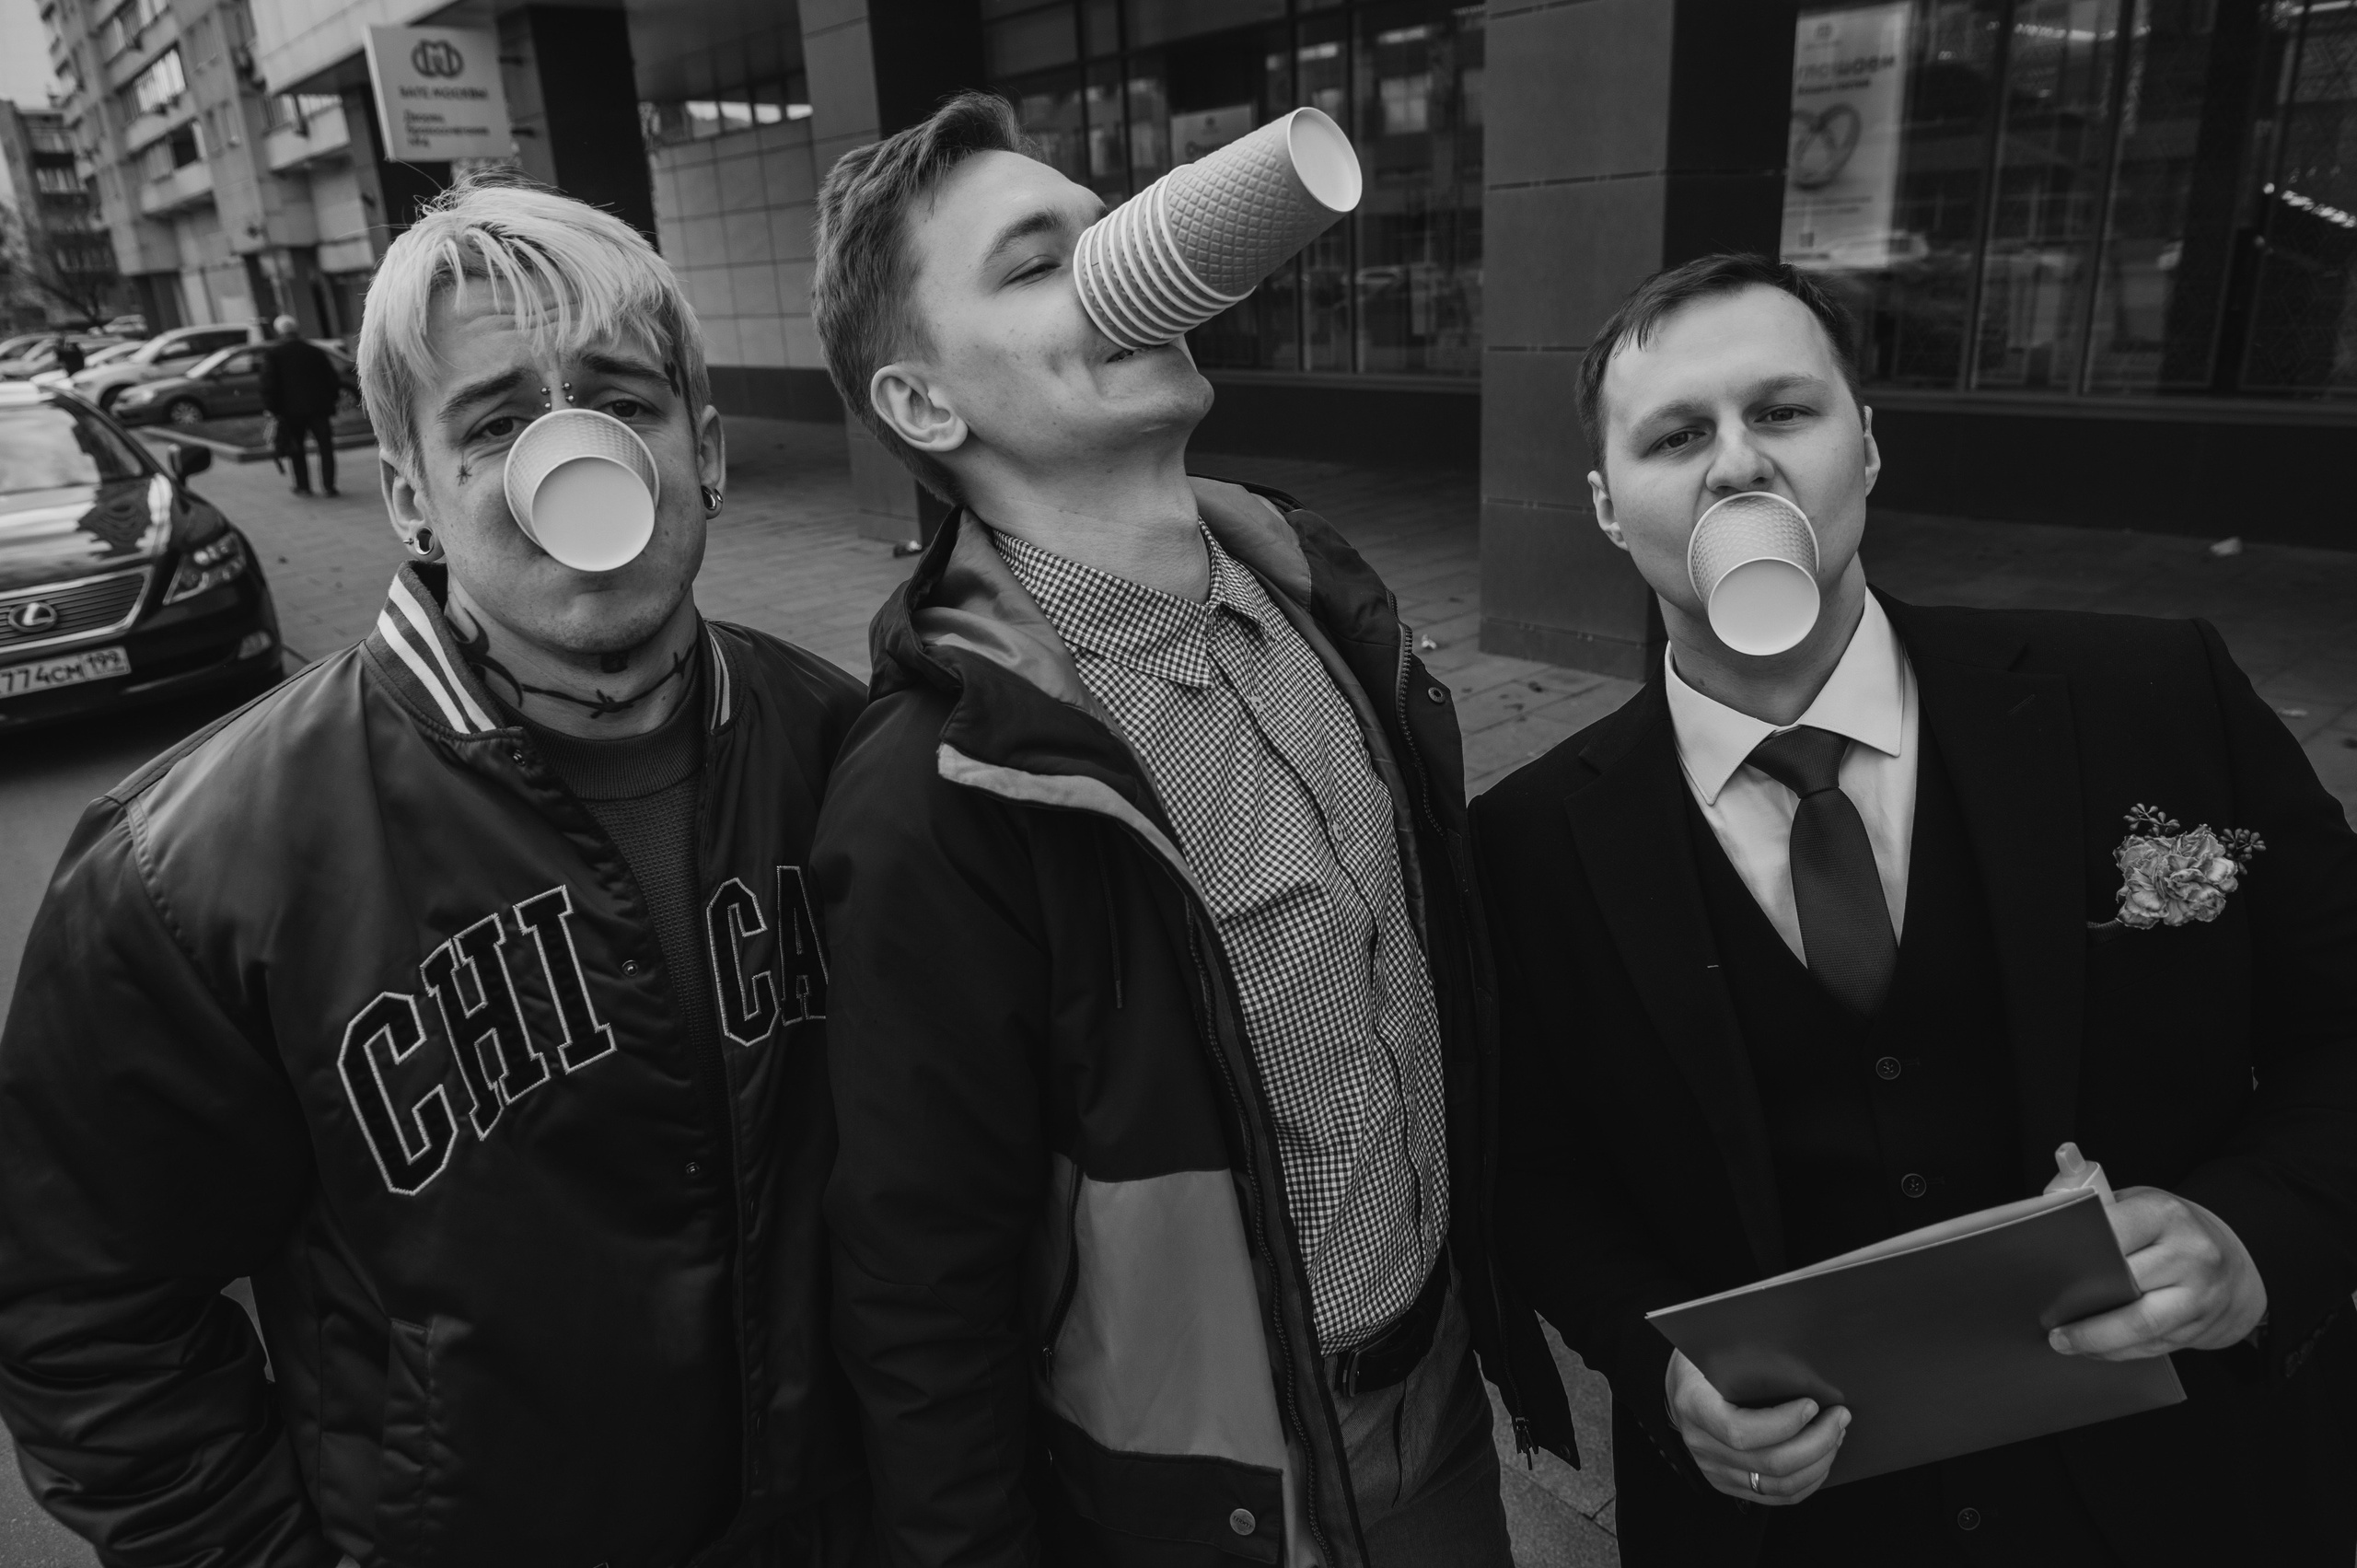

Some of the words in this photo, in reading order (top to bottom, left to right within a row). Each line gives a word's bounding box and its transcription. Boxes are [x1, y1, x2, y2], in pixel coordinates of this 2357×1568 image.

[0, 663, 86, 692] 774CM
[87, 650, 122, 668] 199
[339, 885, 616, 1195] CHI
